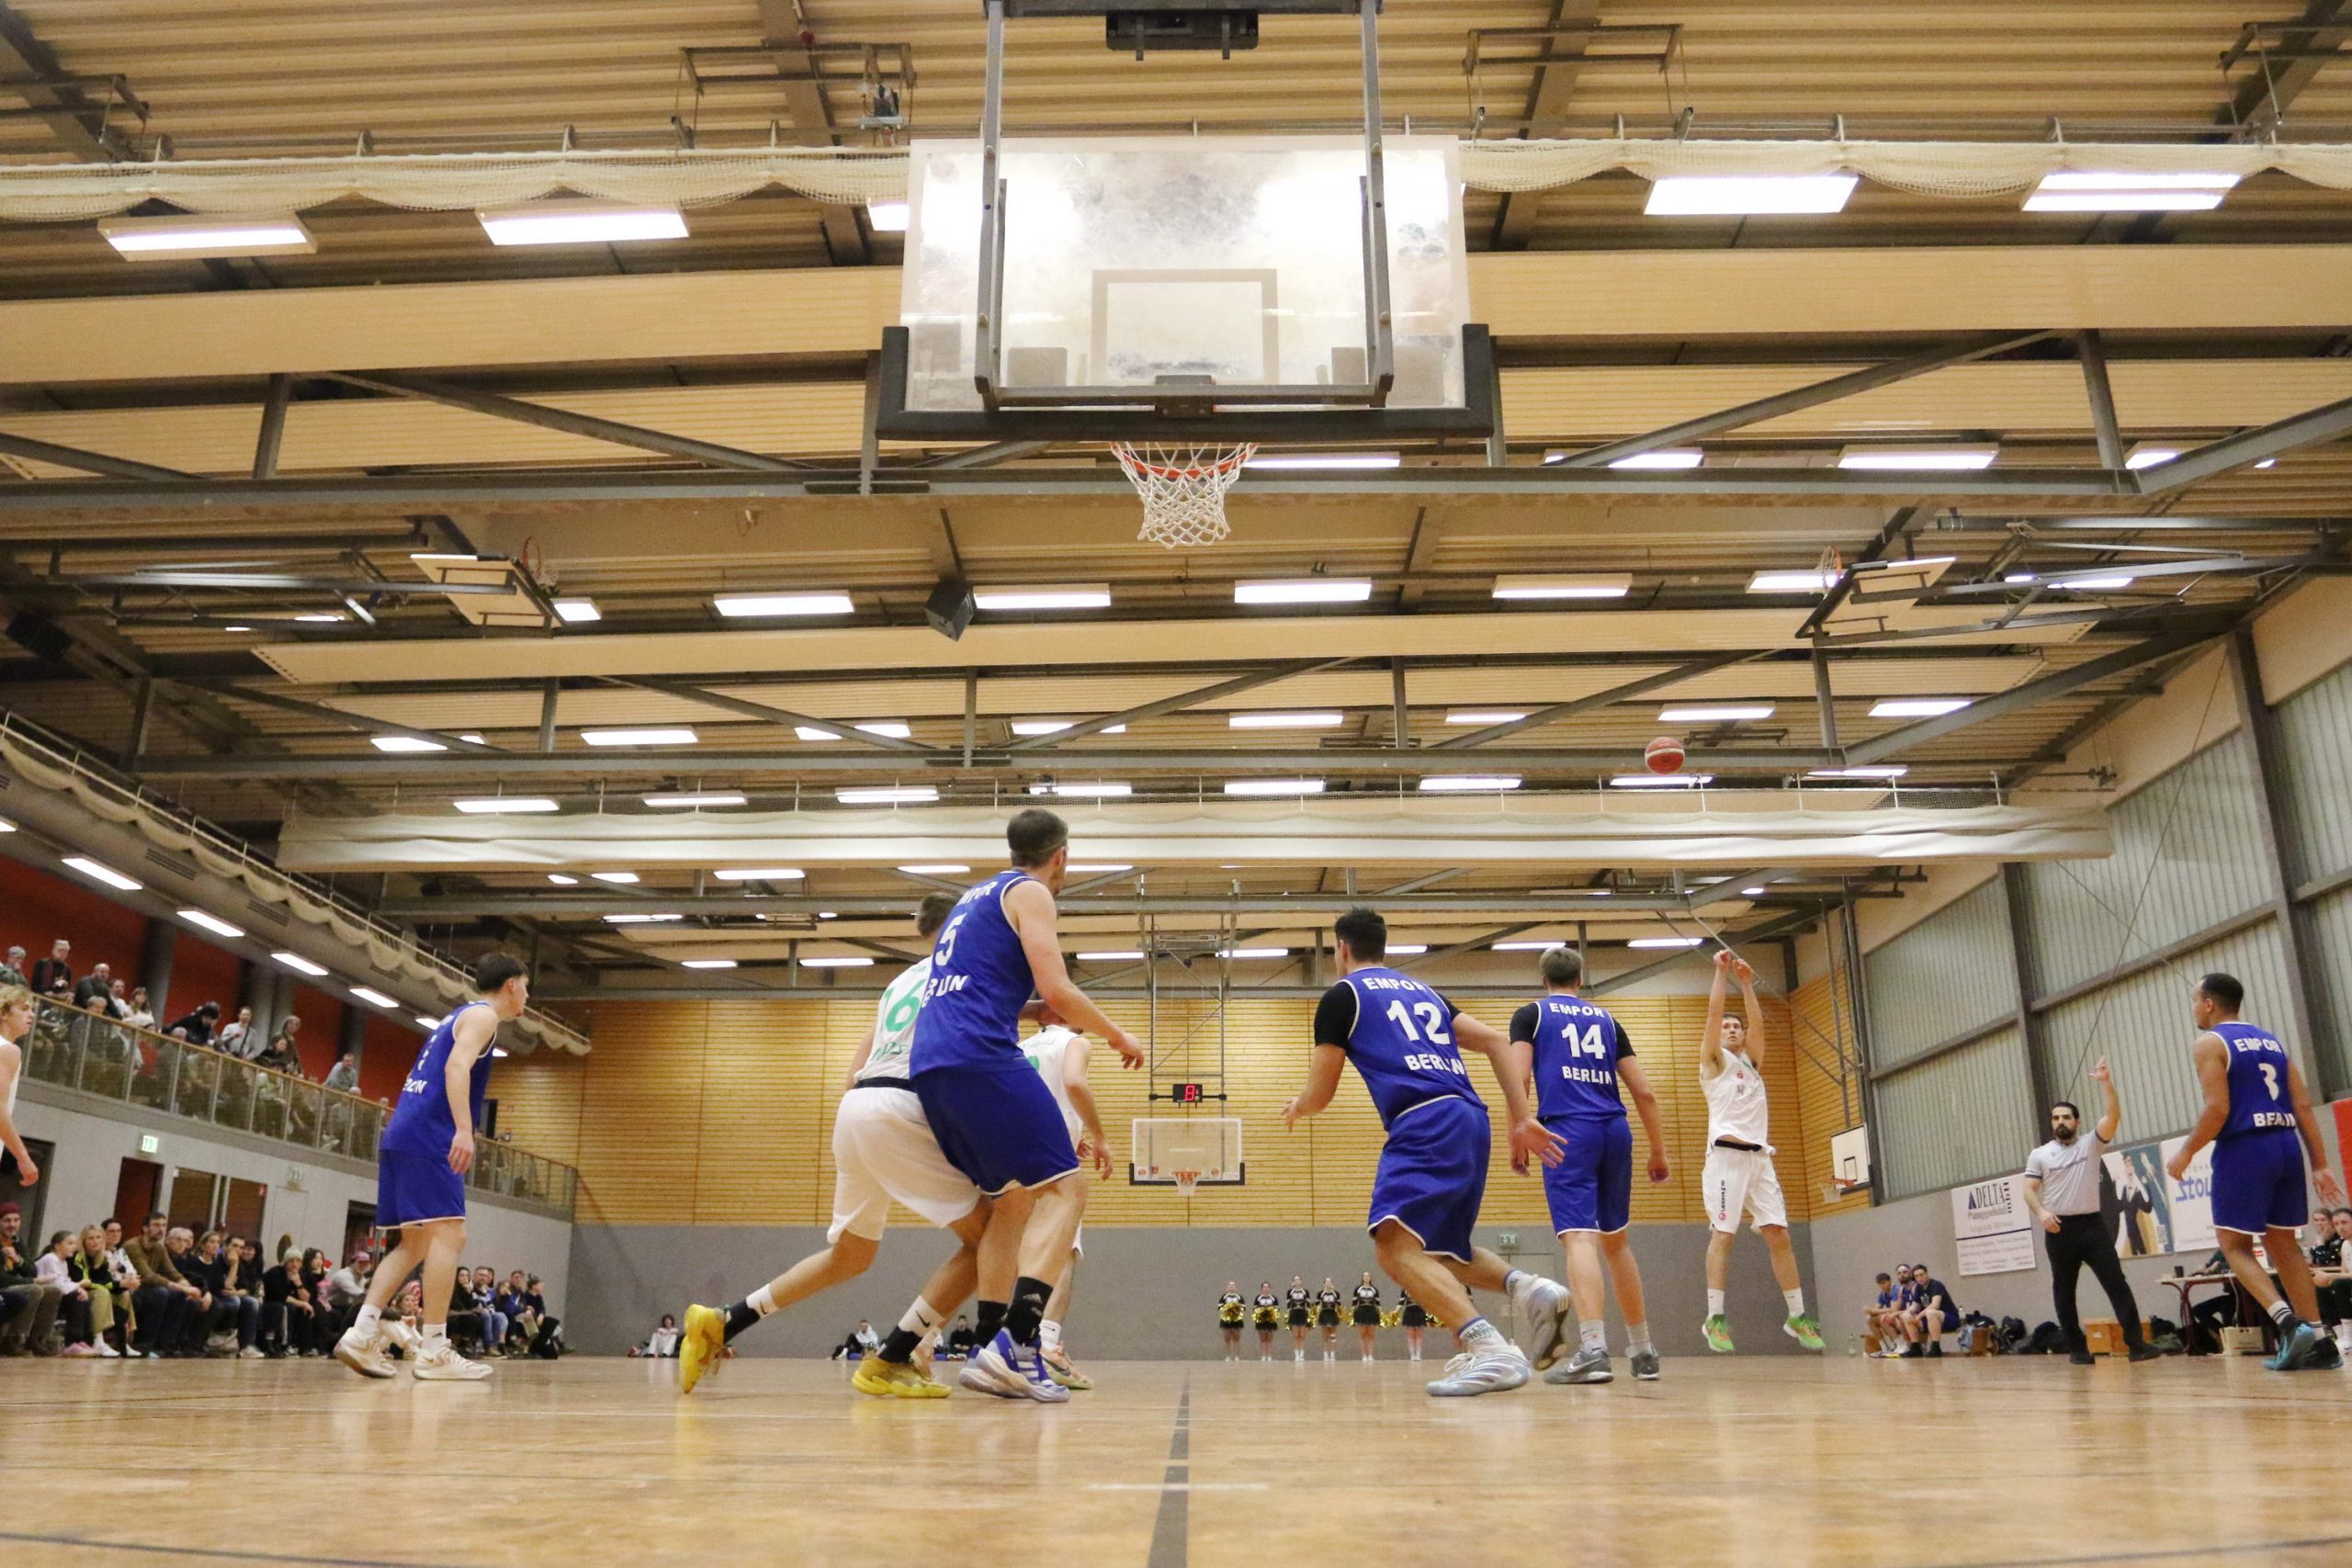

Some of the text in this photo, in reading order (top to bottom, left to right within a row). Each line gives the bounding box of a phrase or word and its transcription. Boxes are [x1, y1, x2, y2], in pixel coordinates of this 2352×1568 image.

[935, 912, 967, 966] 5
[1386, 999, 1451, 1044] 12
[1549, 1002, 1605, 1018] EMPOR
[1561, 1022, 1606, 1060] 14
[2233, 1037, 2282, 1054] EMPOR
[1562, 1066, 1612, 1085] BERLIN
[2258, 1063, 2279, 1101] 3
